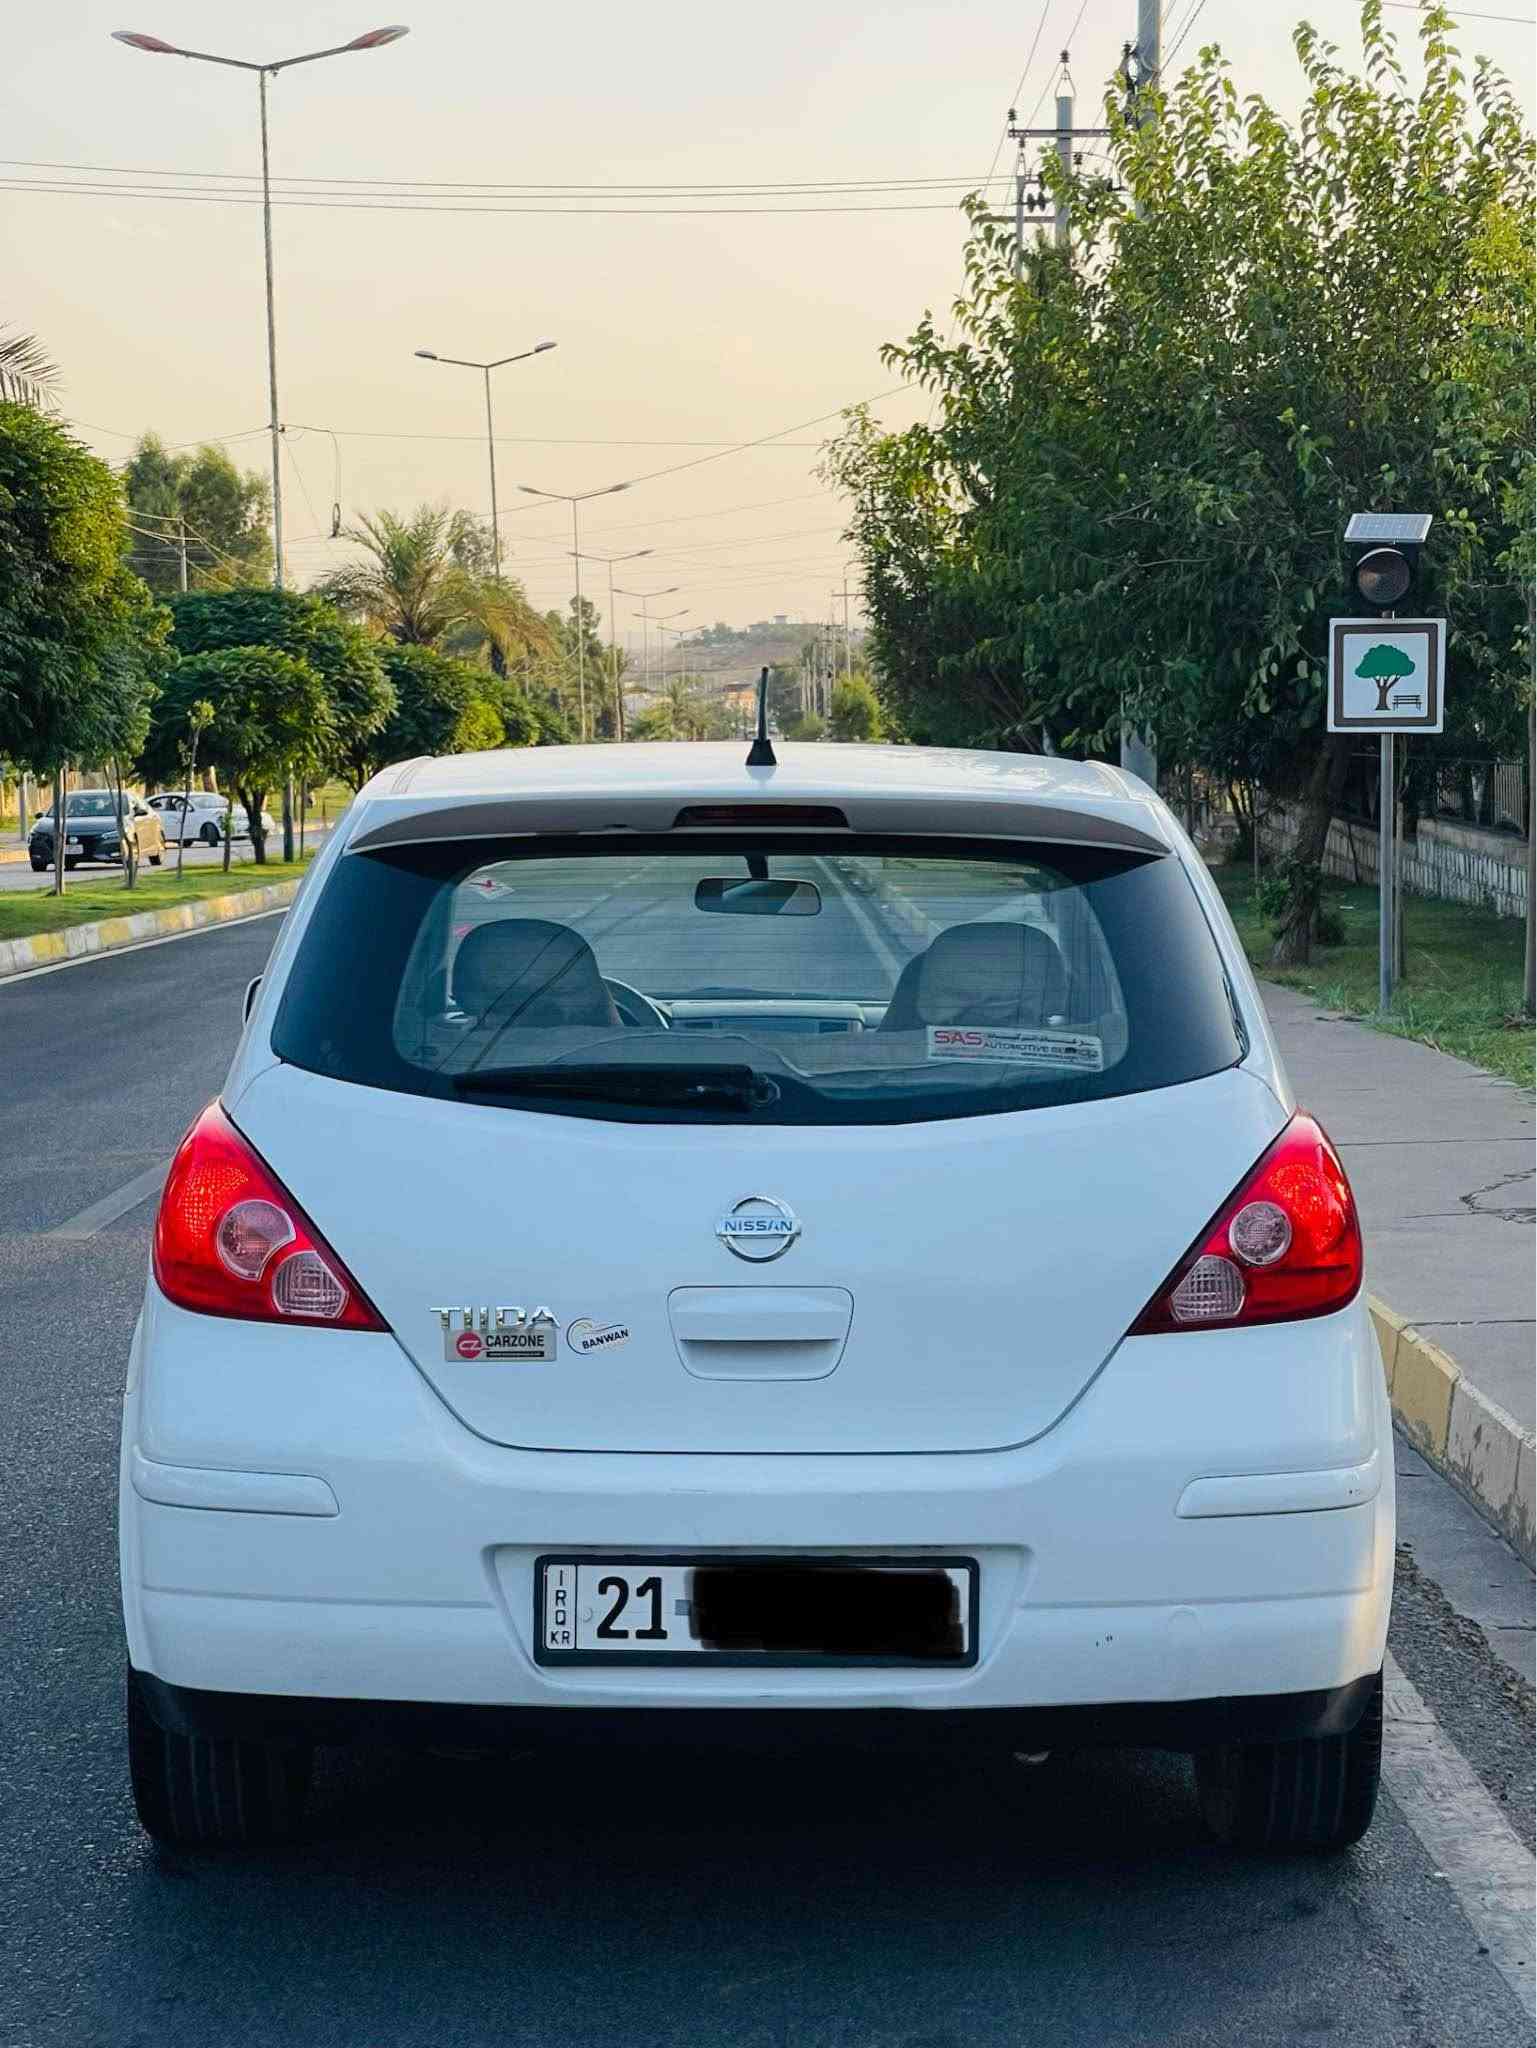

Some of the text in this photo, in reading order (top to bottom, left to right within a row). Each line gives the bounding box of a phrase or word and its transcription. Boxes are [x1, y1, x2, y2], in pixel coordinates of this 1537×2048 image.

[934, 1030, 983, 1046] SAS
[984, 1040, 1050, 1053] AUTOMOTIVE
[725, 1220, 793, 1231] NISSAN
[430, 1305, 561, 1329] TIIDA
[486, 1335, 545, 1347] CARZONE
[582, 1328, 629, 1349] BANWAN
[597, 1576, 668, 1640] 21
[550, 1630, 571, 1645] KR
